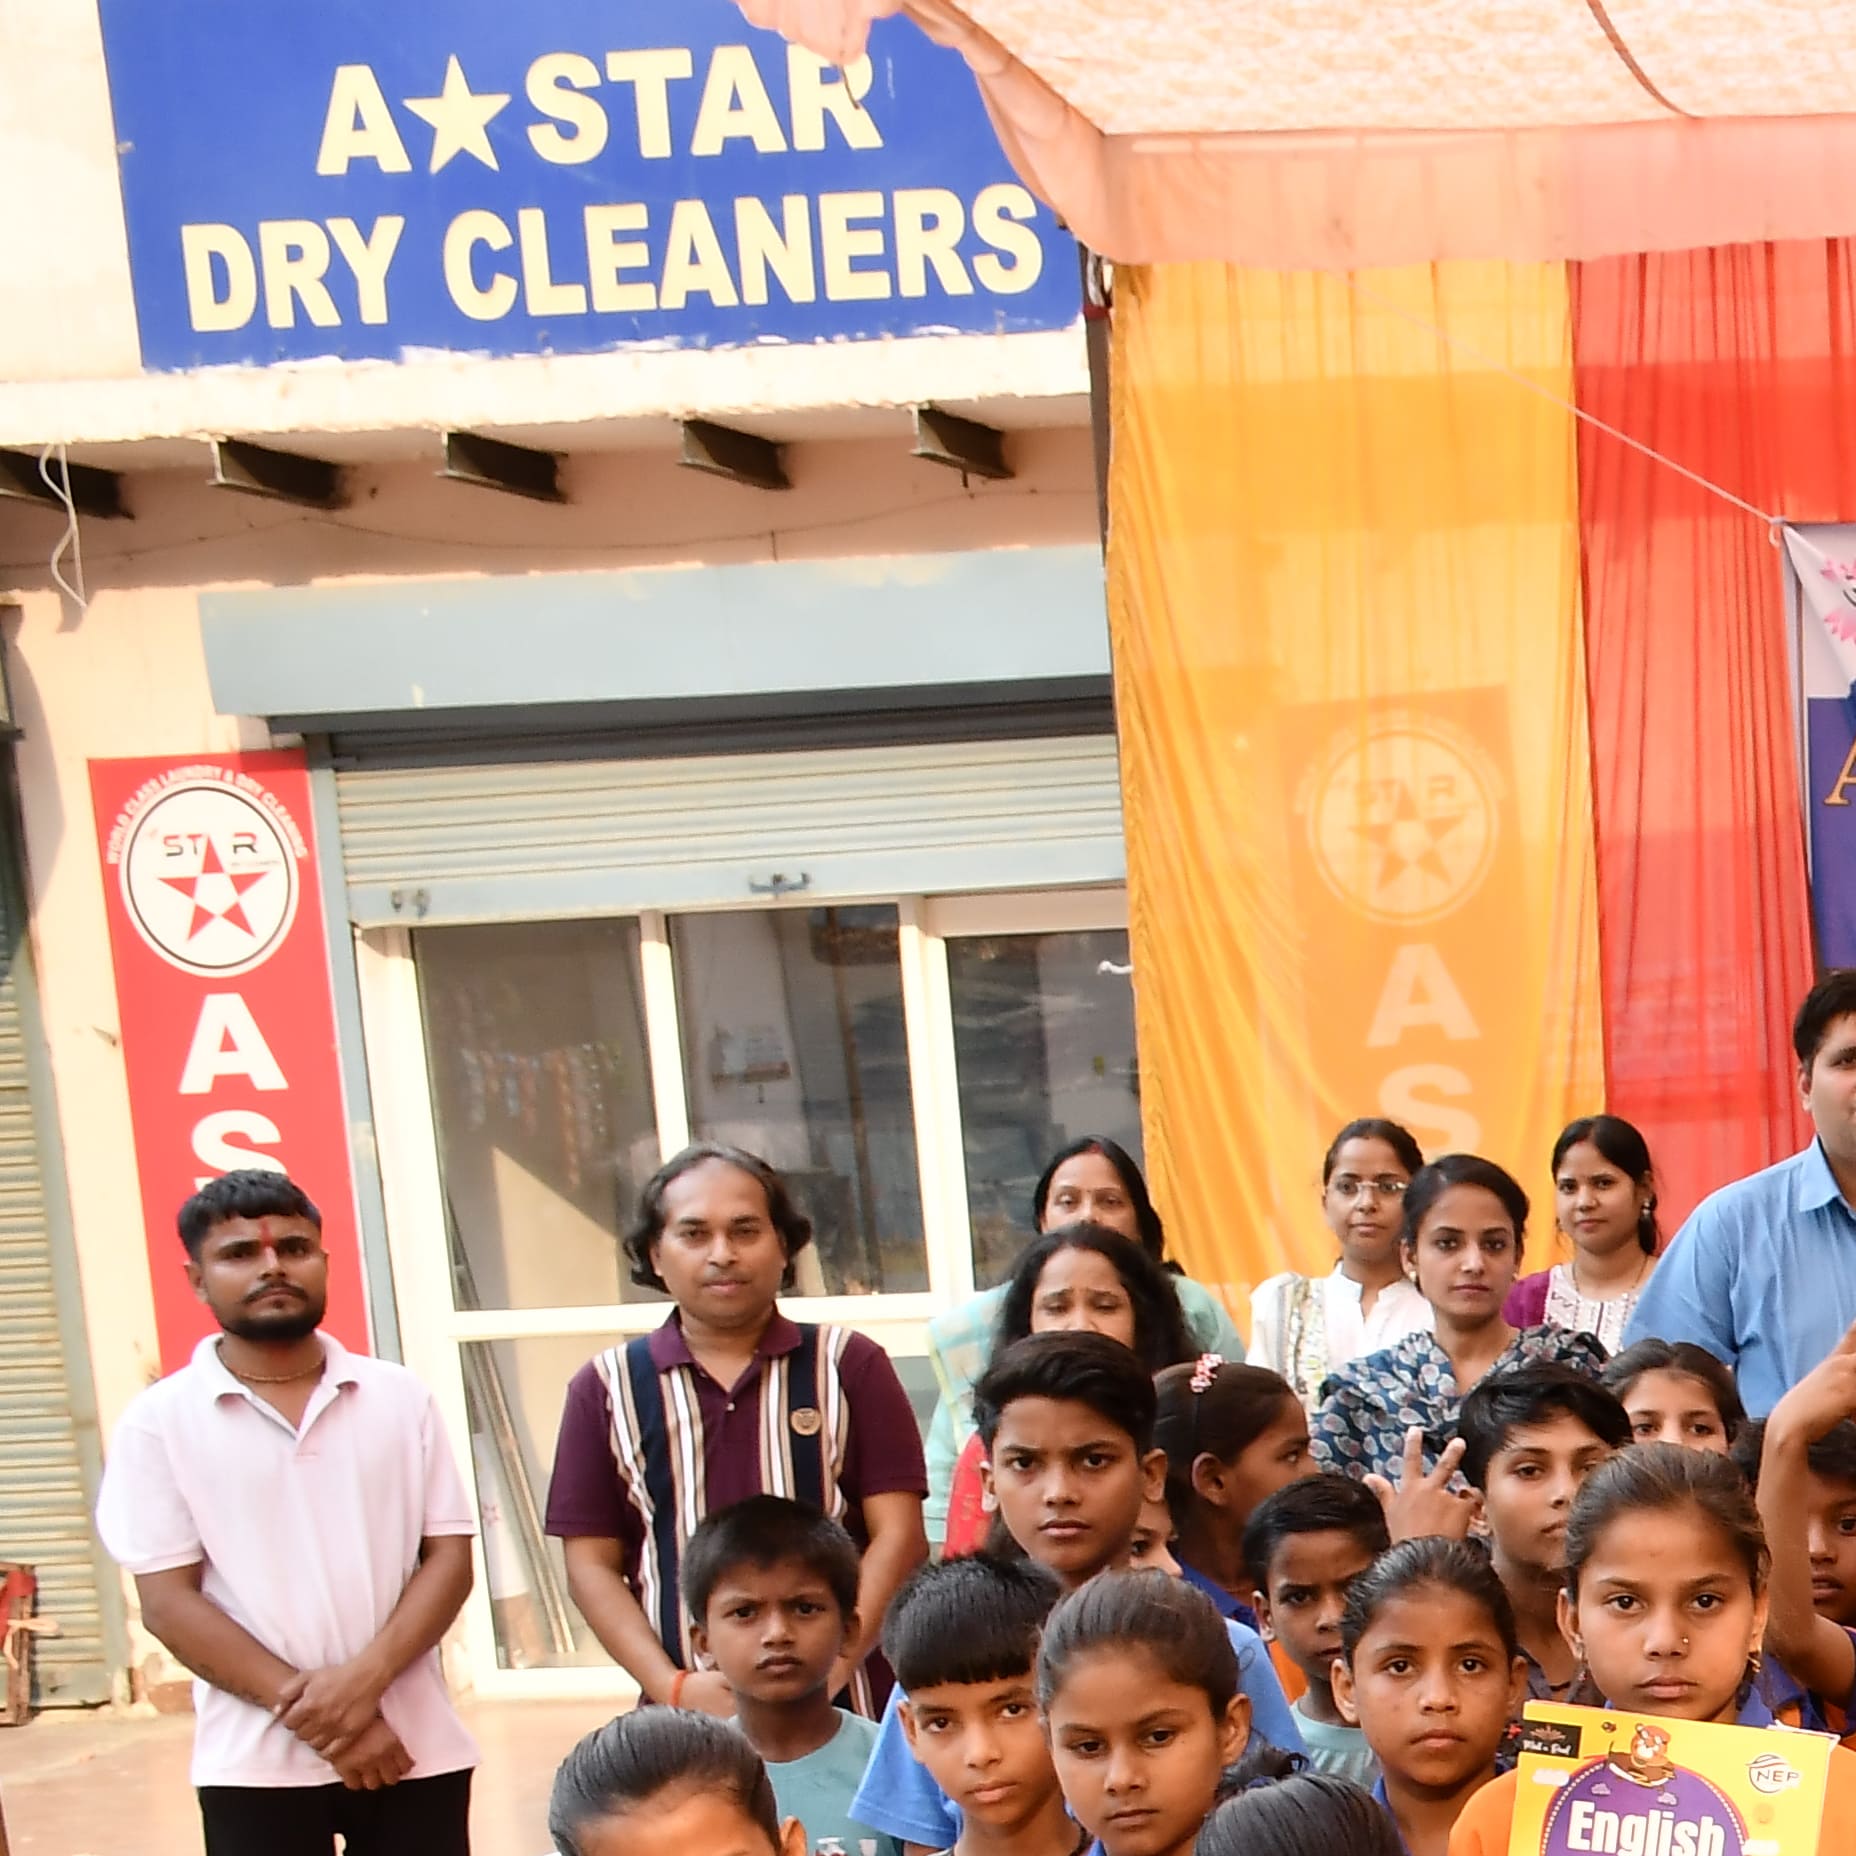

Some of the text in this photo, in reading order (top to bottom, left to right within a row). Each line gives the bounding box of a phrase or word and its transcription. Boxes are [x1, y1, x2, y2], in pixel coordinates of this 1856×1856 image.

[526, 45, 884, 164] STAR
[181, 184, 1043, 332] DRY CLEANERS
[1756, 1768, 1800, 1785] NEP
